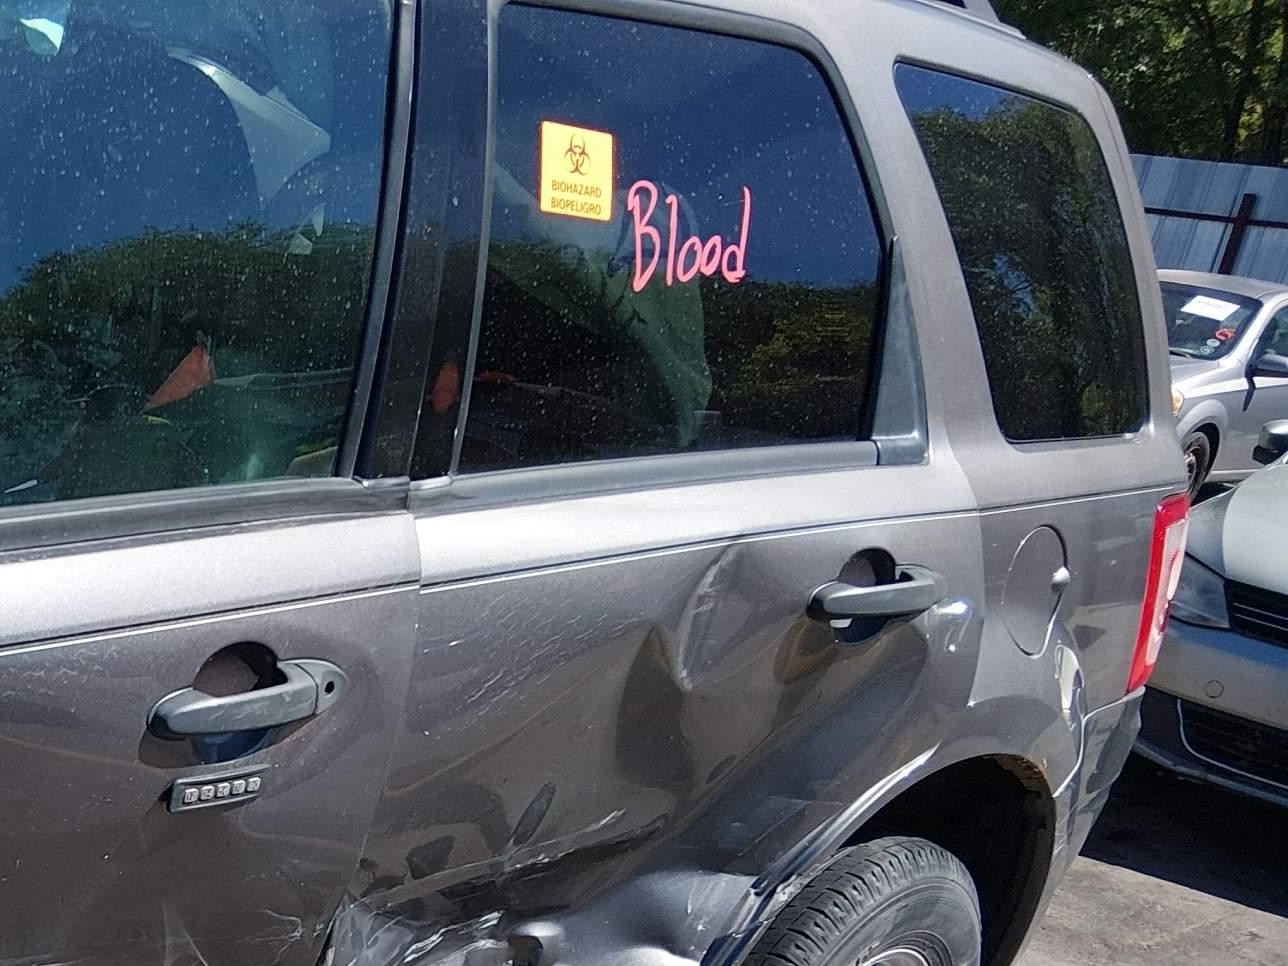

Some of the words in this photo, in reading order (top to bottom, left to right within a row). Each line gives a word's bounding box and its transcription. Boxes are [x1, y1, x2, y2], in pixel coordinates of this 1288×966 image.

[551, 179, 603, 199] BIOHAZARD
[550, 197, 603, 216] BIOPELIGRO
[628, 180, 751, 292] Blood
